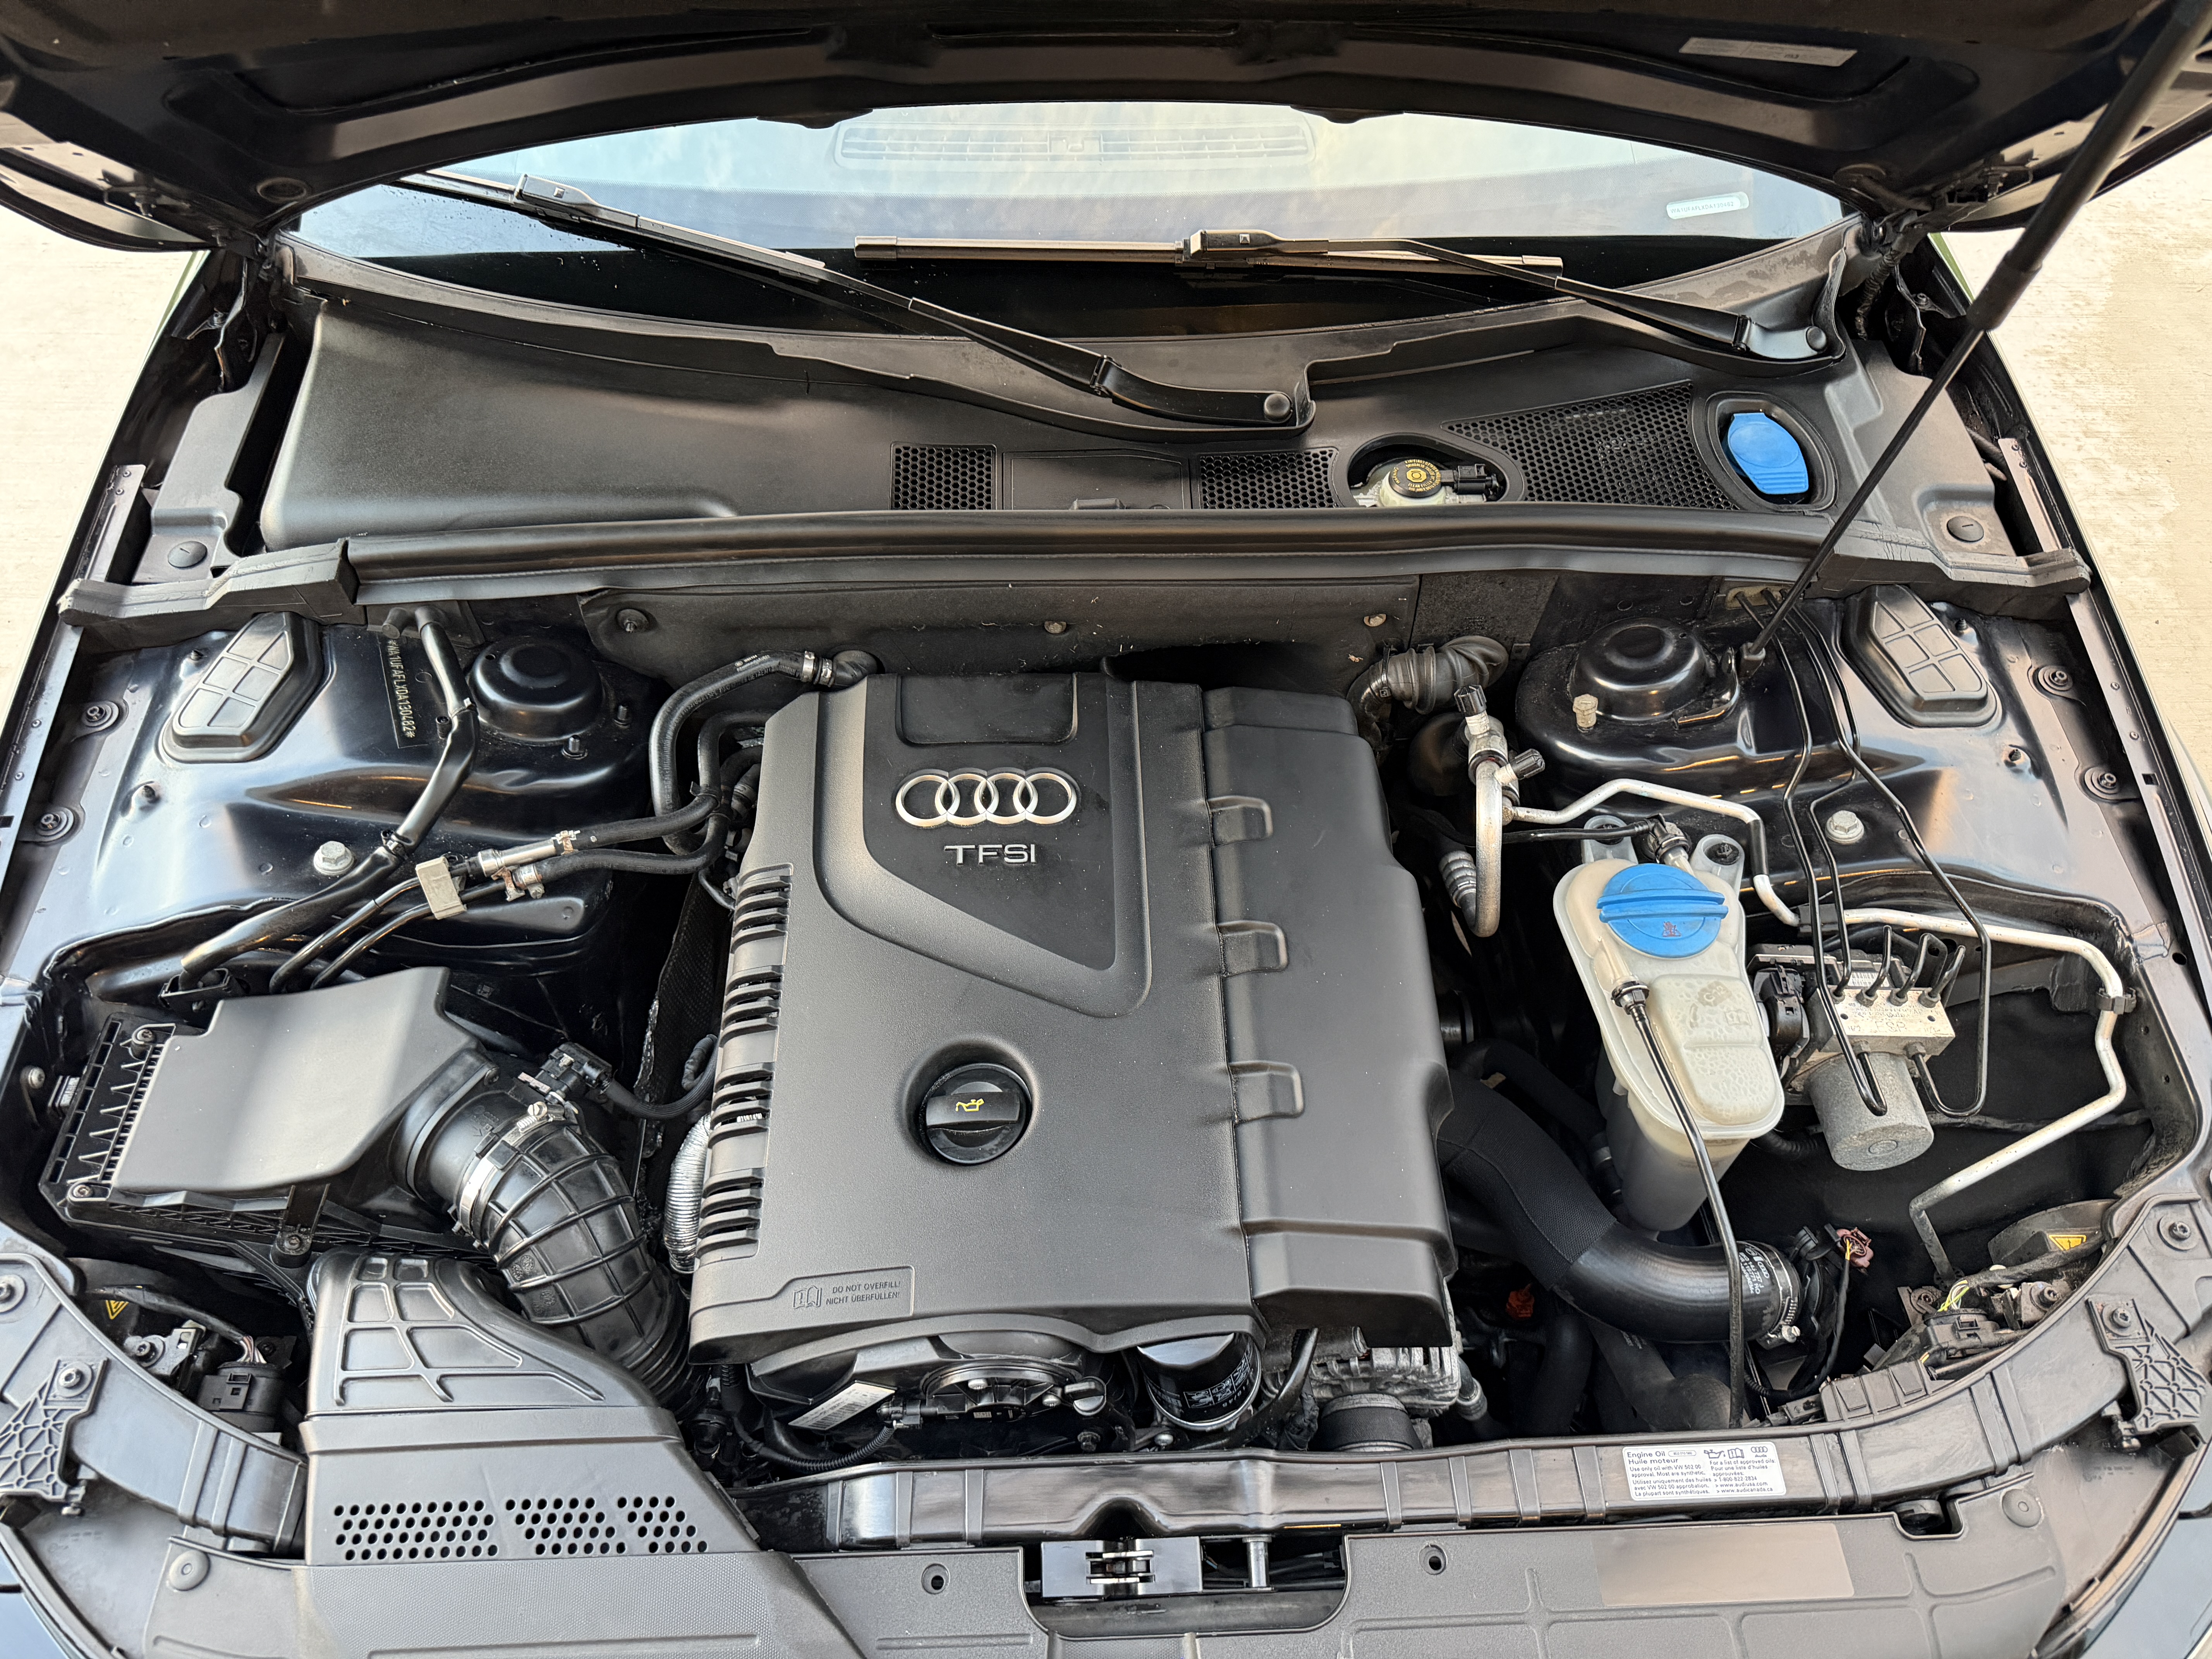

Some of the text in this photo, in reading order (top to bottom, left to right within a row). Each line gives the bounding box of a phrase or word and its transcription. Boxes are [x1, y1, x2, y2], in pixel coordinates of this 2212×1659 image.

[944, 844, 1037, 866] TFSI
[1704, 985, 1726, 1001] G12
[1875, 1021, 1906, 1033] ESP
[864, 1281, 900, 1290] OVERFILL!
[826, 1296, 848, 1305] NICHT
